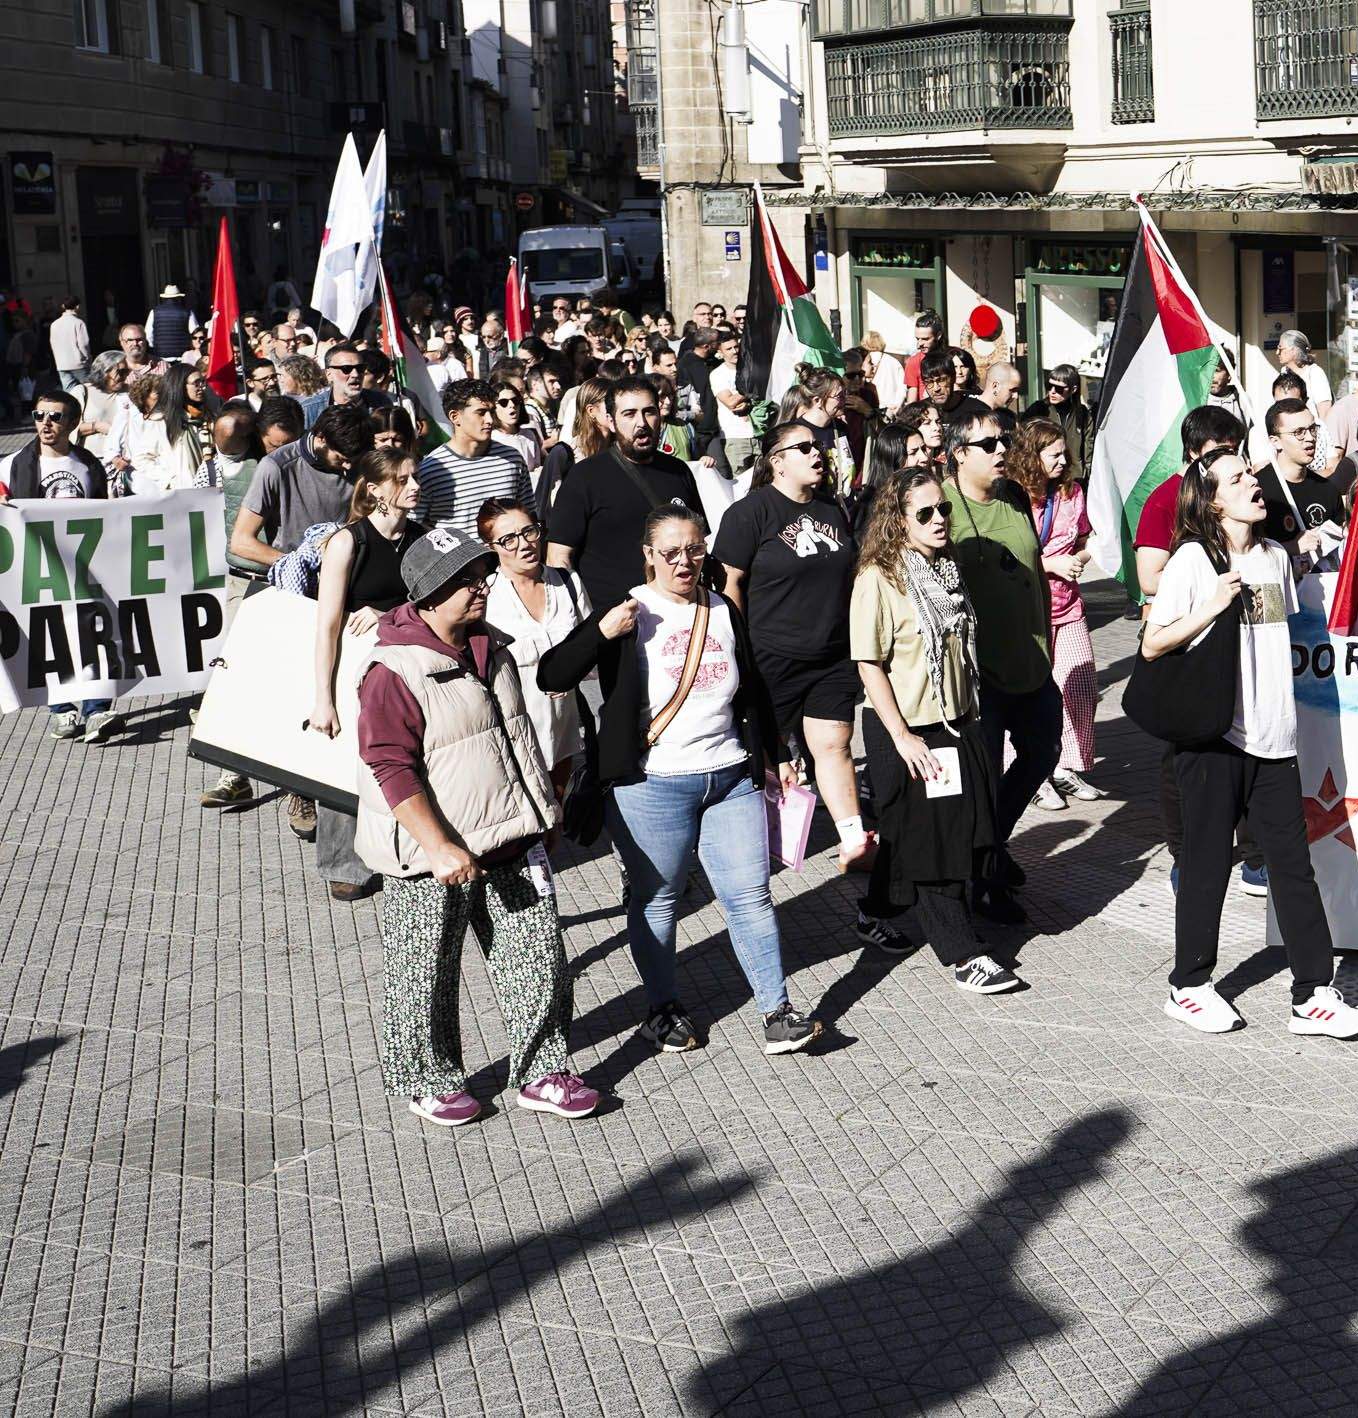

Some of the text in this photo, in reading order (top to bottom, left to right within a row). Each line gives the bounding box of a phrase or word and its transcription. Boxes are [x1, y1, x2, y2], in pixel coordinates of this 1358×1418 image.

[131, 514, 166, 596] E
[189, 511, 225, 591] L
[814, 520, 844, 547] RURAL
[180, 592, 223, 673] P
[1292, 643, 1336, 679] DO
